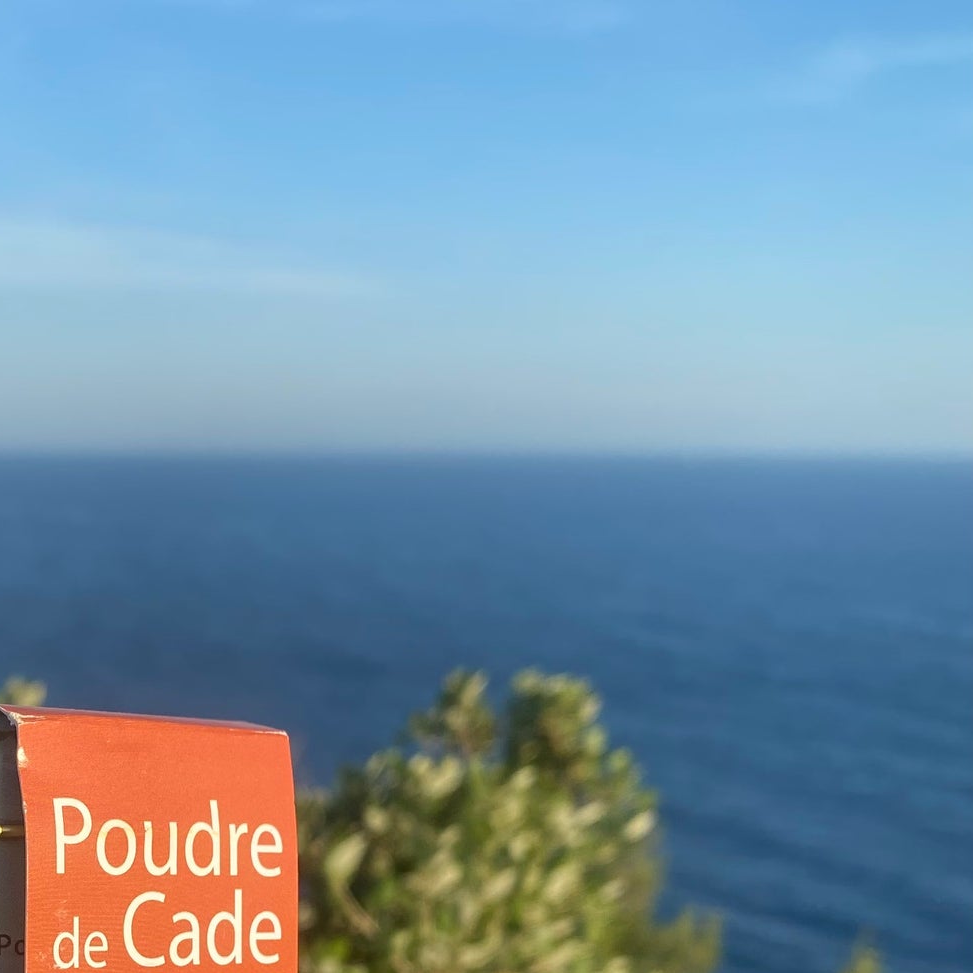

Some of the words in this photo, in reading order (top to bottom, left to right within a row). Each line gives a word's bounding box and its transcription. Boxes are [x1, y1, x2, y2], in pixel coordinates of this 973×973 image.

[52, 797, 284, 878] Poudre
[52, 915, 109, 969] de
[122, 888, 282, 968] Cade
